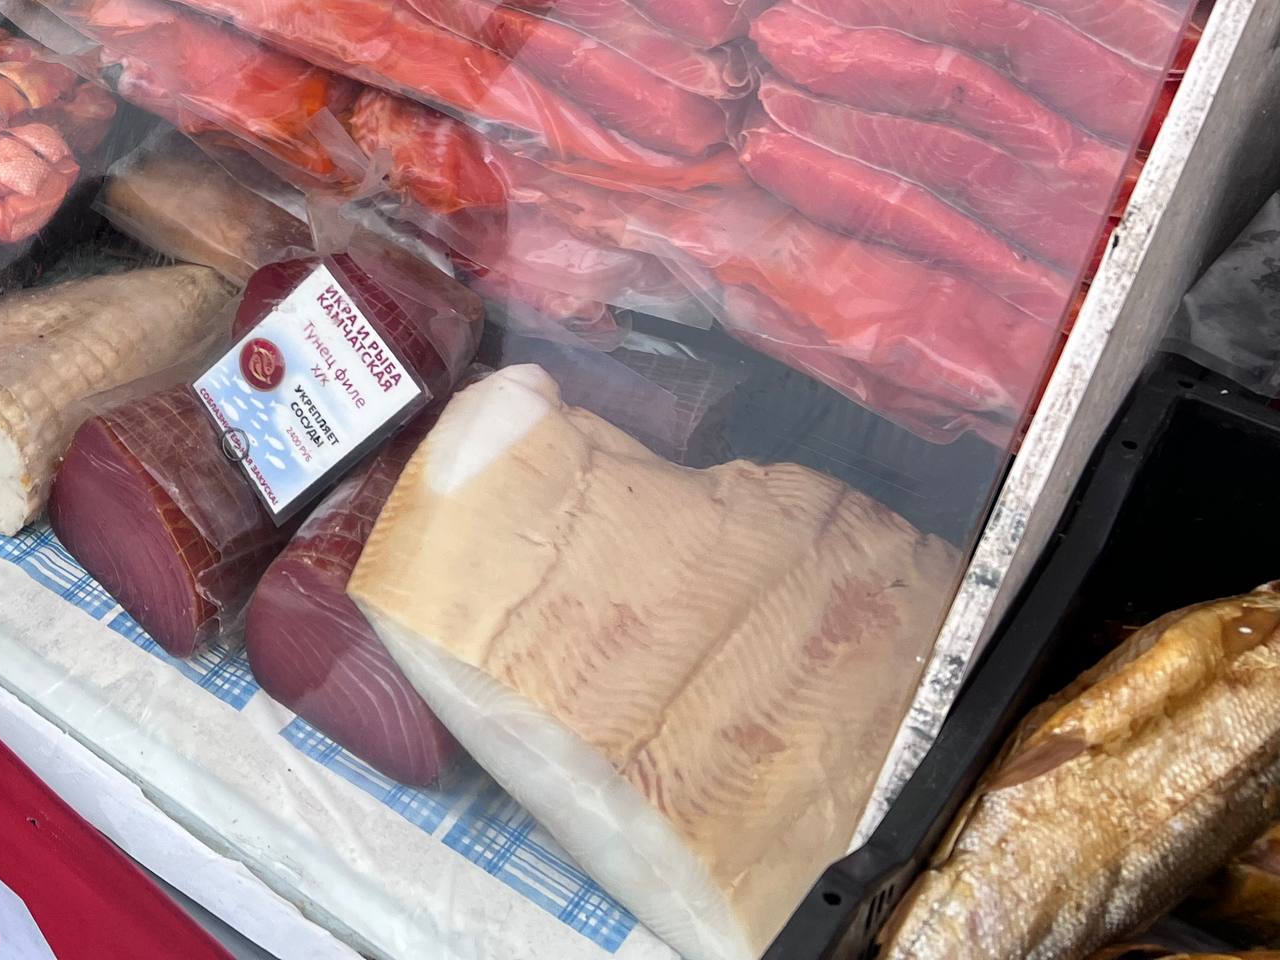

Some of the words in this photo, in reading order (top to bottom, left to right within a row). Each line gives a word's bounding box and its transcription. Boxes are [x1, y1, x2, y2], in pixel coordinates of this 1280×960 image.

[298, 319, 340, 370] Тунец
[331, 364, 370, 410] филе
[314, 291, 394, 392] КАМЧАТСКАЯ
[323, 283, 360, 327] ИКРА
[355, 325, 370, 341] И
[366, 339, 405, 386] РЫБА
[284, 425, 302, 447] 2400
[298, 444, 313, 463] РУБ
[287, 400, 324, 449] СОСУДЫ
[292, 384, 340, 447] УКРЕПЛЯЕТ
[248, 463, 279, 506] ЗАКУСКА!
